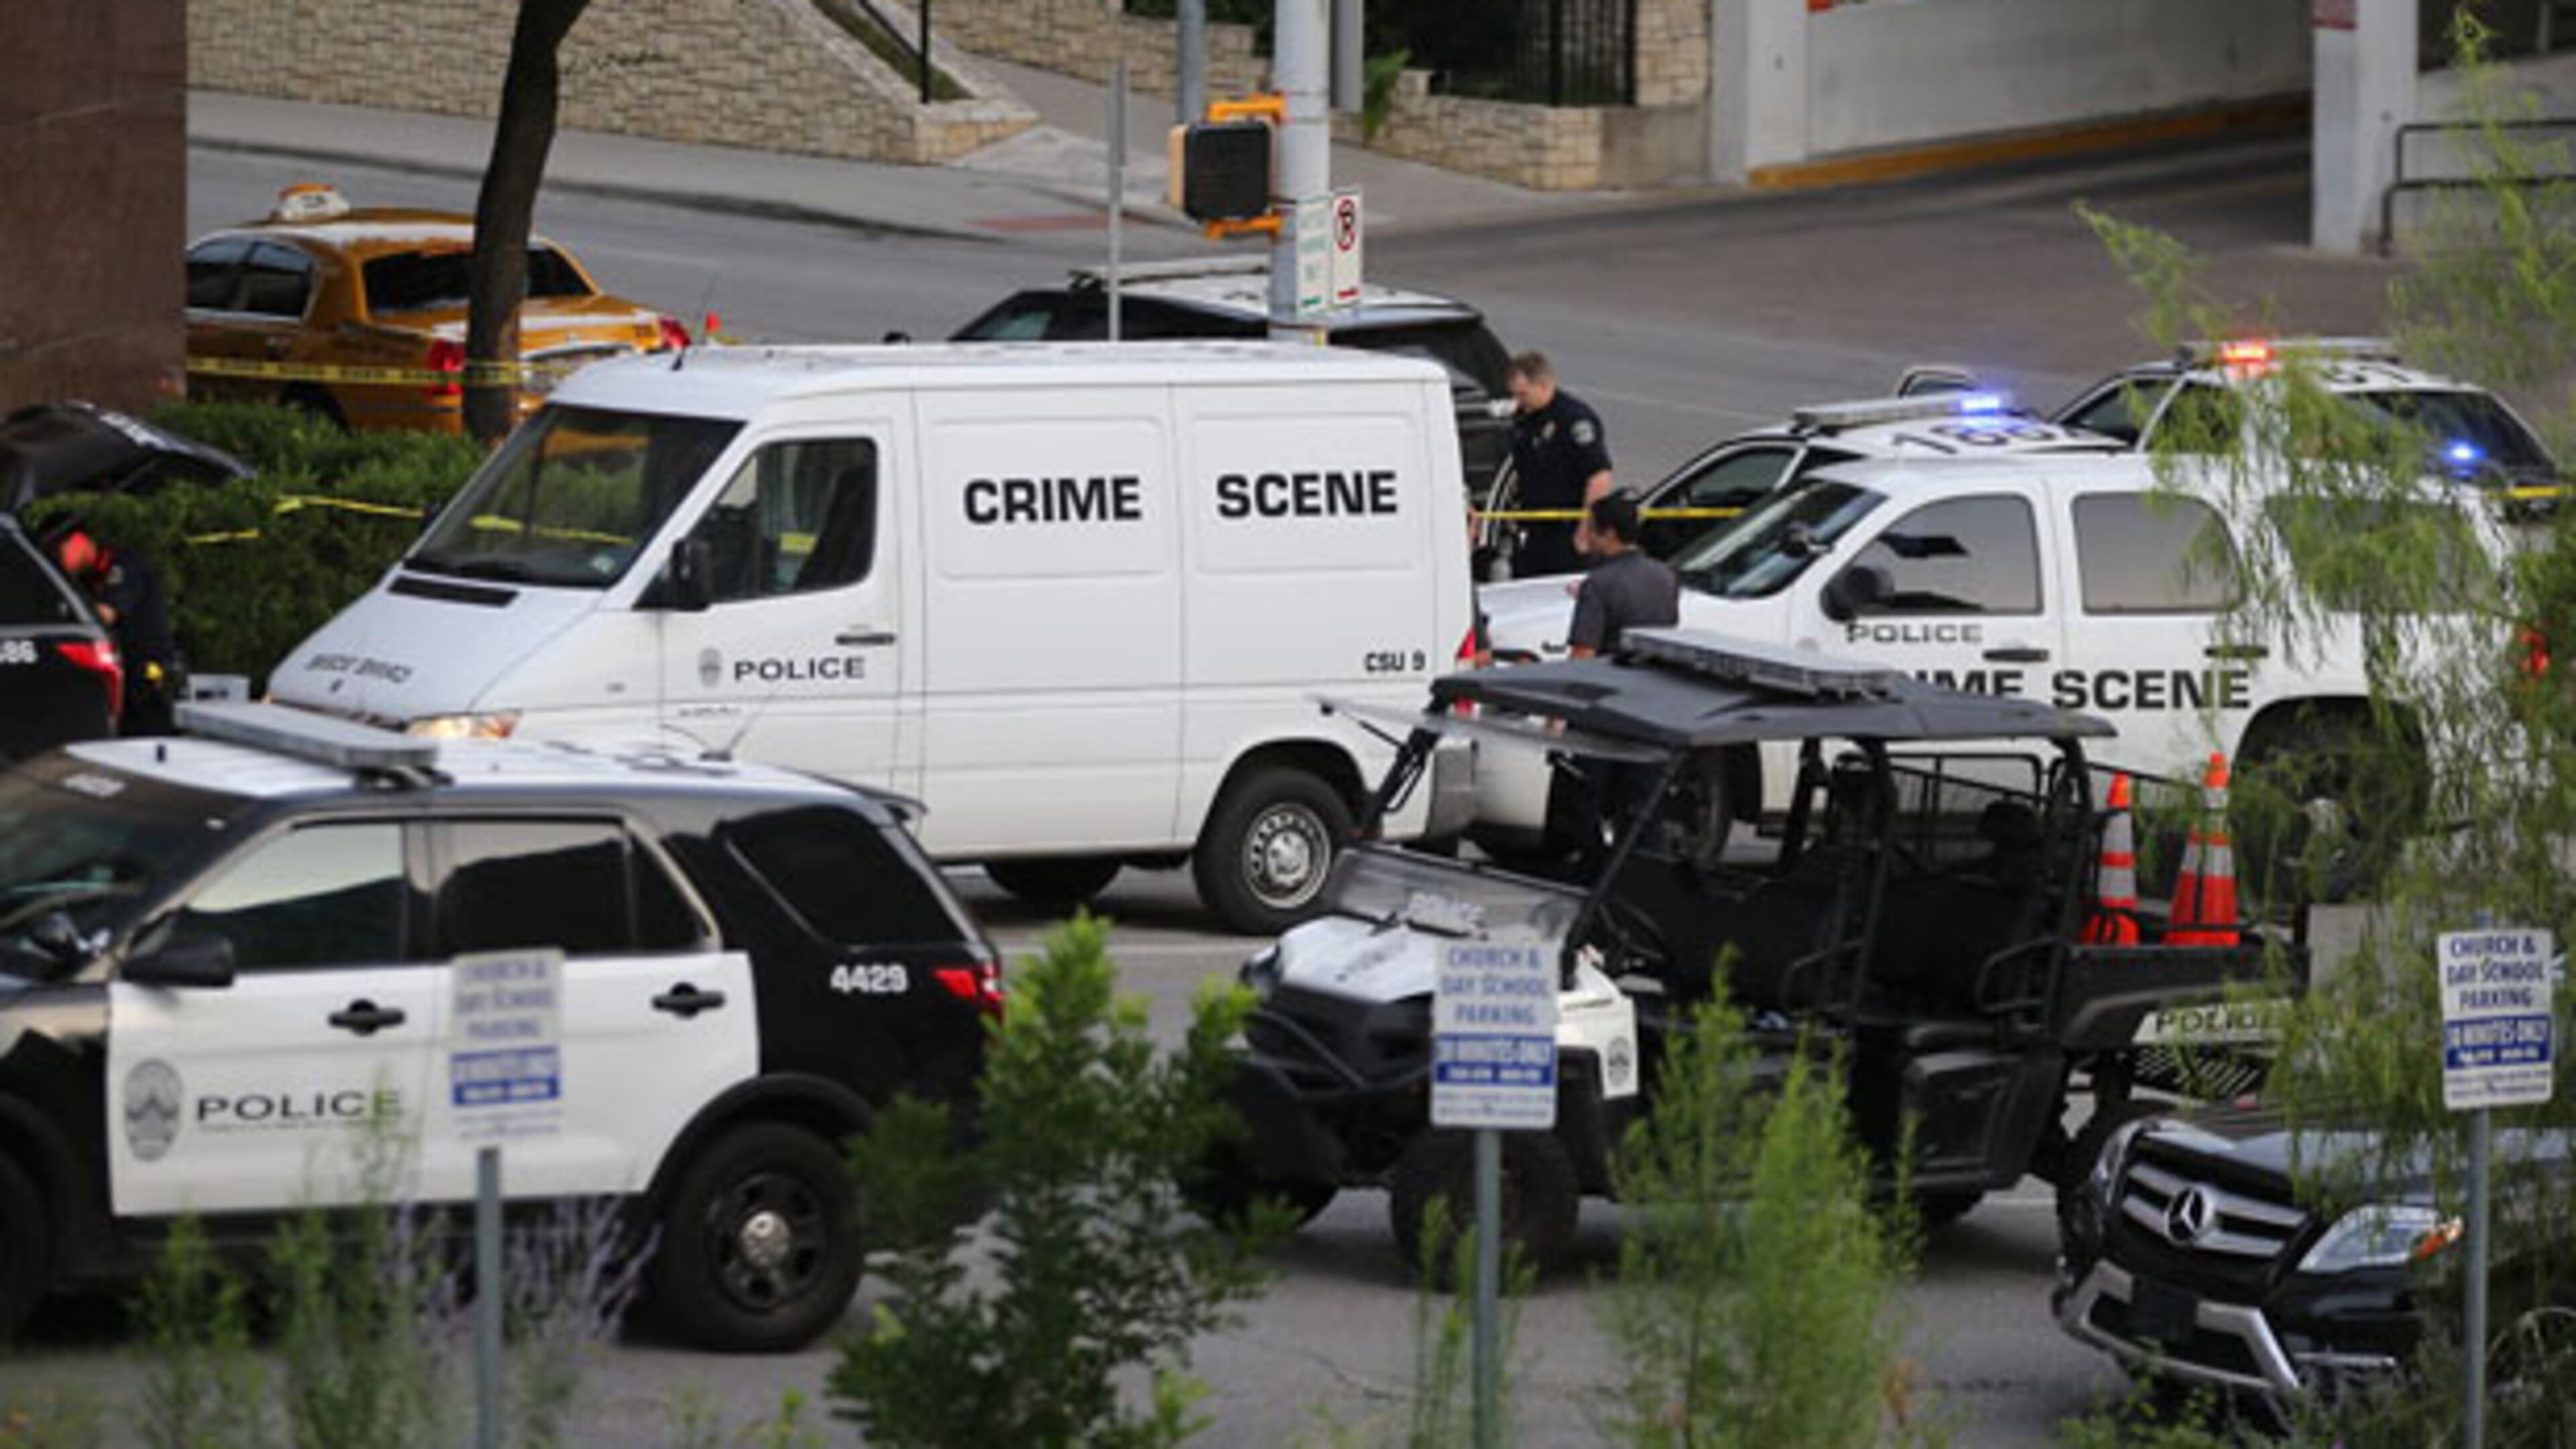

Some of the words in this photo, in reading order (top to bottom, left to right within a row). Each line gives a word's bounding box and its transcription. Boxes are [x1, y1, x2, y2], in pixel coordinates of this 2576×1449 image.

[964, 476, 1142, 525] CRIME
[1216, 471, 1399, 518] SCENE
[1847, 623, 1983, 644] POLICE
[735, 657, 866, 681] POLICE
[1364, 653, 1405, 672] CSU
[1412, 651, 1426, 671] 9
[2052, 670, 2251, 710] SCENE
[1448, 947, 1523, 968] CHURCH
[1527, 947, 1541, 968] &
[2451, 936, 2518, 957] CHURCH
[2522, 935, 2536, 955] &
[830, 965, 908, 994] 4429
[1442, 977, 1474, 996] DAY
[1481, 974, 1548, 998] SCHOOL
[2447, 965, 2476, 986] DAY
[2483, 962, 2544, 983] SCHOOL
[2461, 989, 2532, 1009] PARKING
[1454, 1004, 1536, 1024] PARKING
[197, 1090, 400, 1121] POLICE
